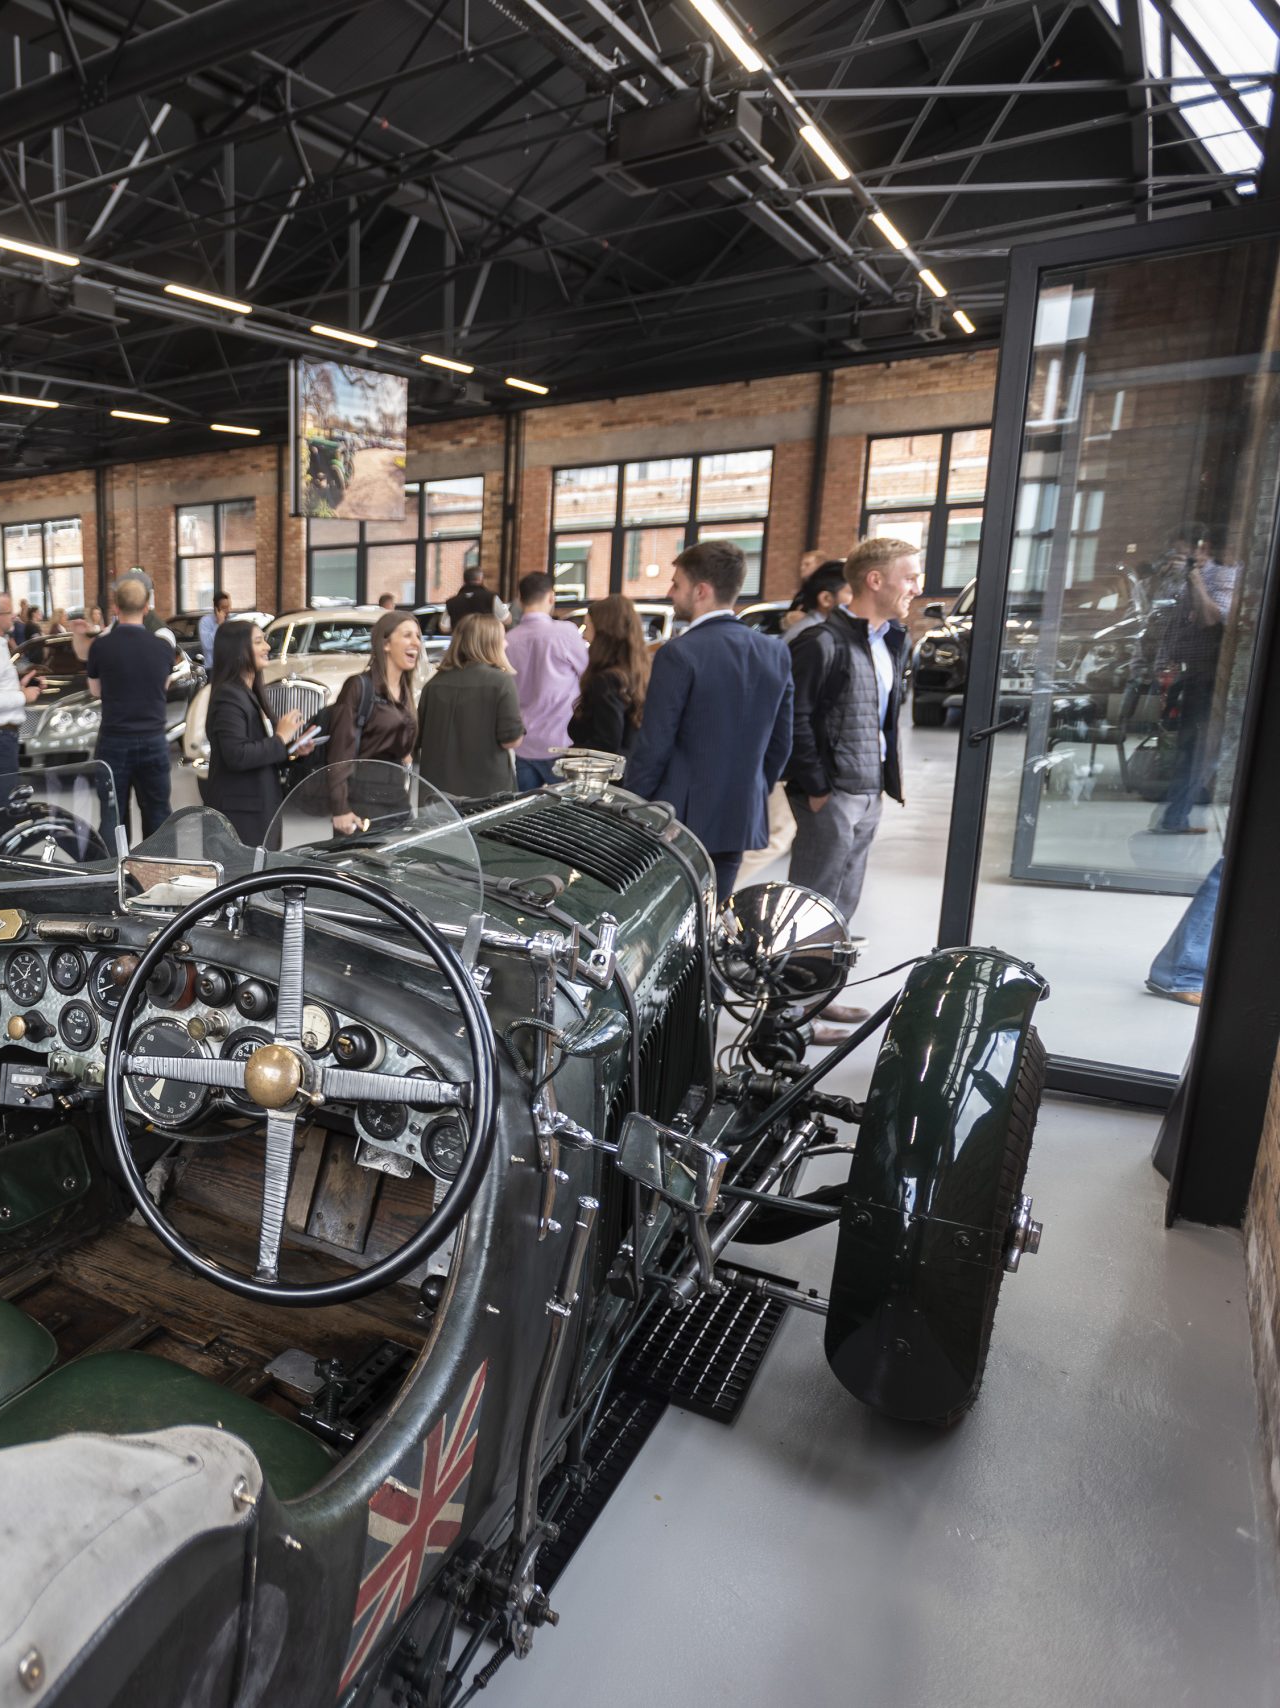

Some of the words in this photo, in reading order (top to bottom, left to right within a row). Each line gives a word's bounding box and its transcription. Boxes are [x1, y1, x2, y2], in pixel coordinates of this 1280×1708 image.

[147, 1033, 155, 1042] 60
[139, 1046, 146, 1054] 55
[237, 1049, 243, 1057] 8
[188, 1091, 196, 1100] 20
[153, 1102, 160, 1110] 35
[179, 1101, 187, 1109] 25
[167, 1106, 174, 1114] 30
